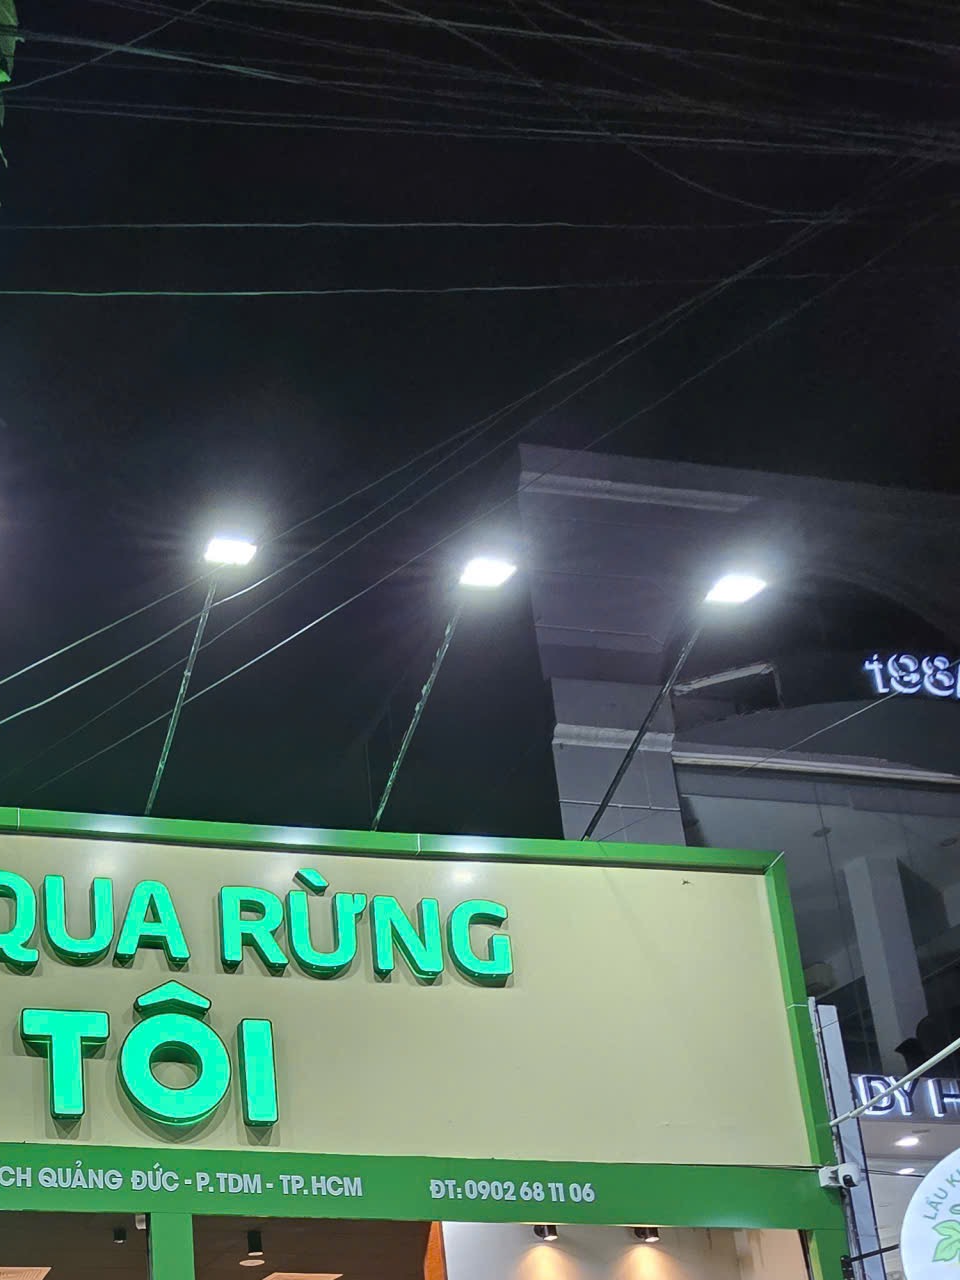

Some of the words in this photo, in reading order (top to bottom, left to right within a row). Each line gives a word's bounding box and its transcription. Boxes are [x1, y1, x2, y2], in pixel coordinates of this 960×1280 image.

[219, 867, 515, 984] RỪNG
[20, 979, 280, 1127] TÔI
[38, 1160, 124, 1191] QUẢNG
[131, 1162, 180, 1192] ĐỨC
[464, 1179, 517, 1201] 0902
[519, 1181, 545, 1202] 68
[548, 1182, 566, 1202] 11
[569, 1183, 596, 1203] 06
